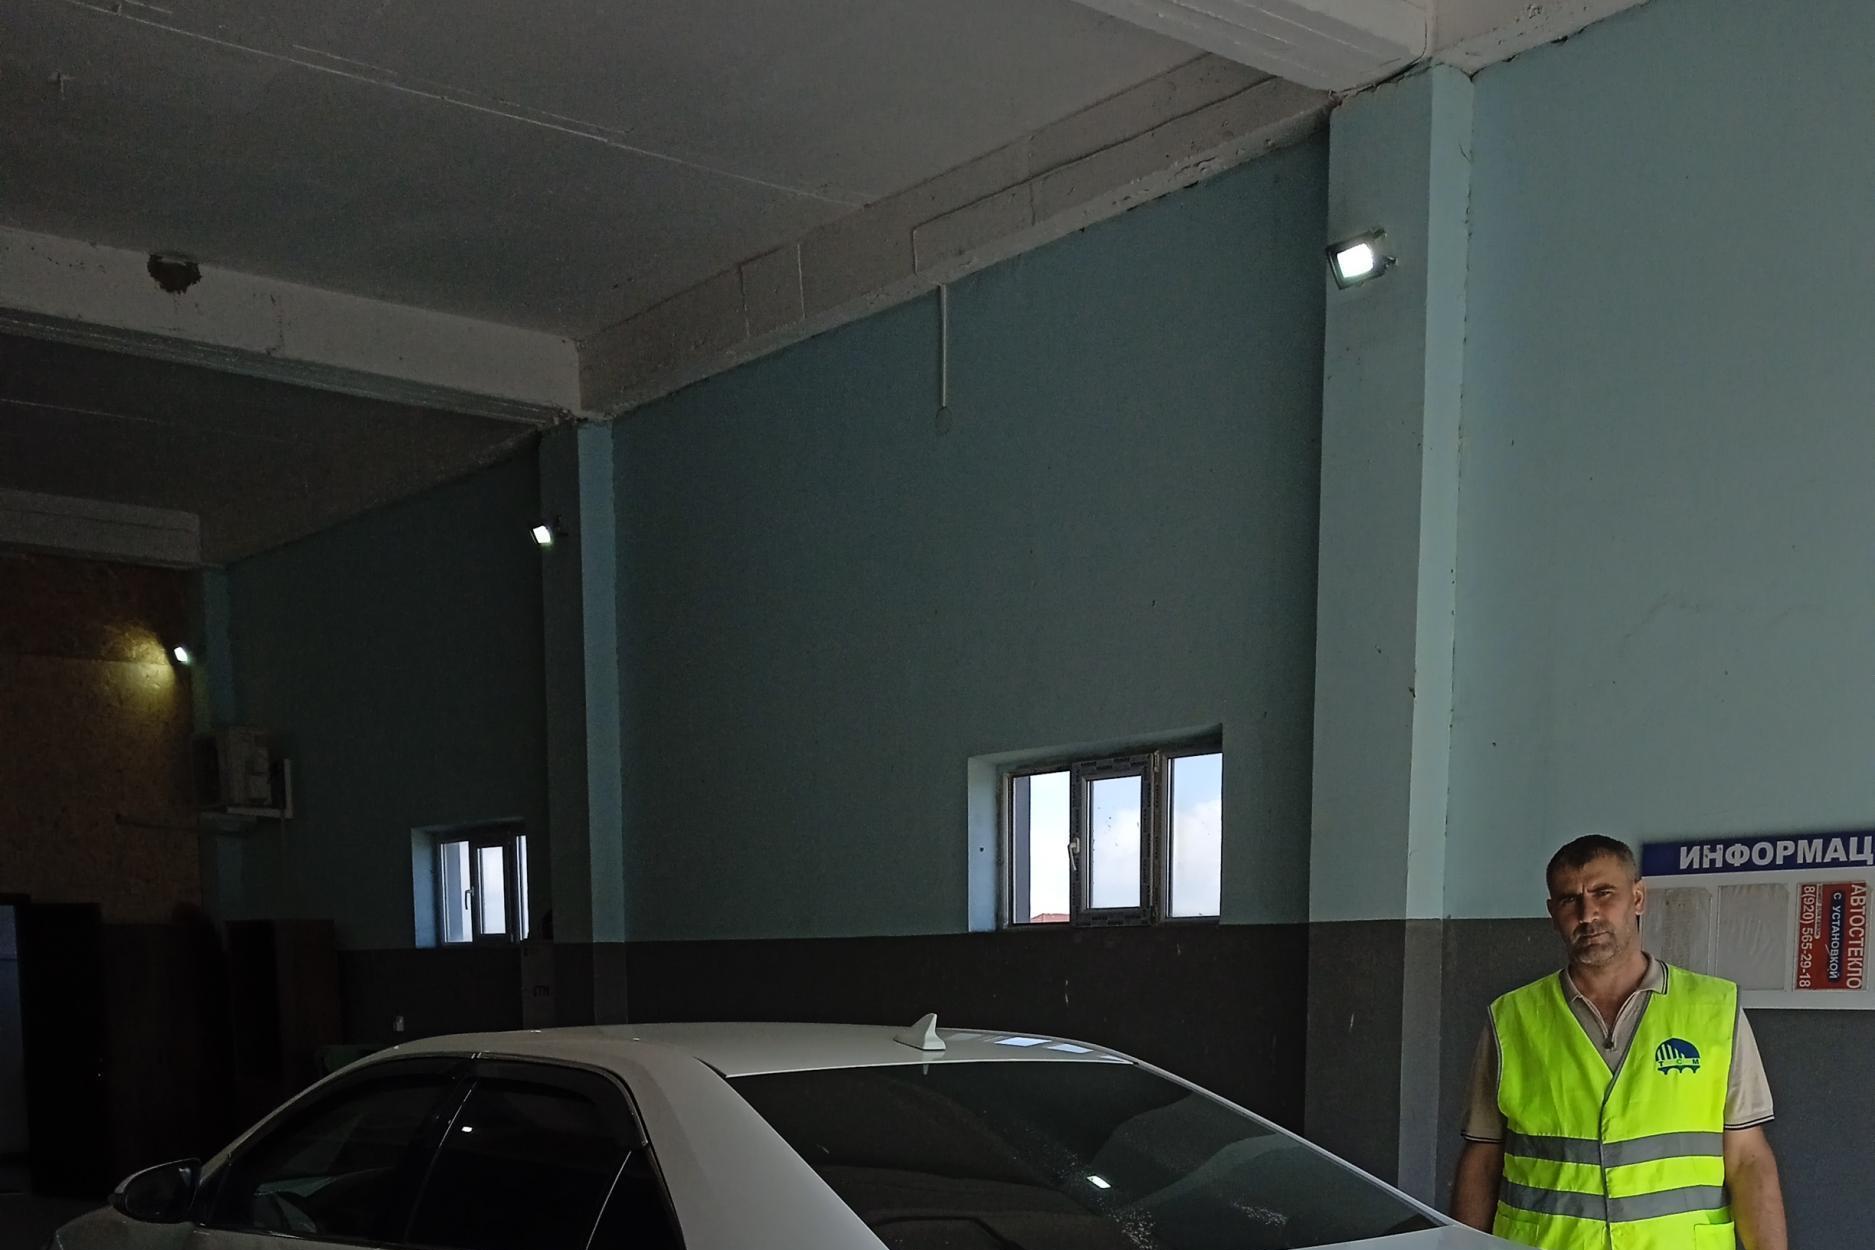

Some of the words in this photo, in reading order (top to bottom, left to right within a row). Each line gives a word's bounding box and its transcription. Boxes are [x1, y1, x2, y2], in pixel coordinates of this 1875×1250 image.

[1679, 836, 1874, 870] ИНФОРМАЦ
[1800, 885, 1816, 924] 8(920)
[1799, 927, 1813, 988] 565-29-18
[1828, 905, 1842, 980] УСТАНОВКОЙ
[1846, 884, 1867, 989] АВТОСТЕКЛО
